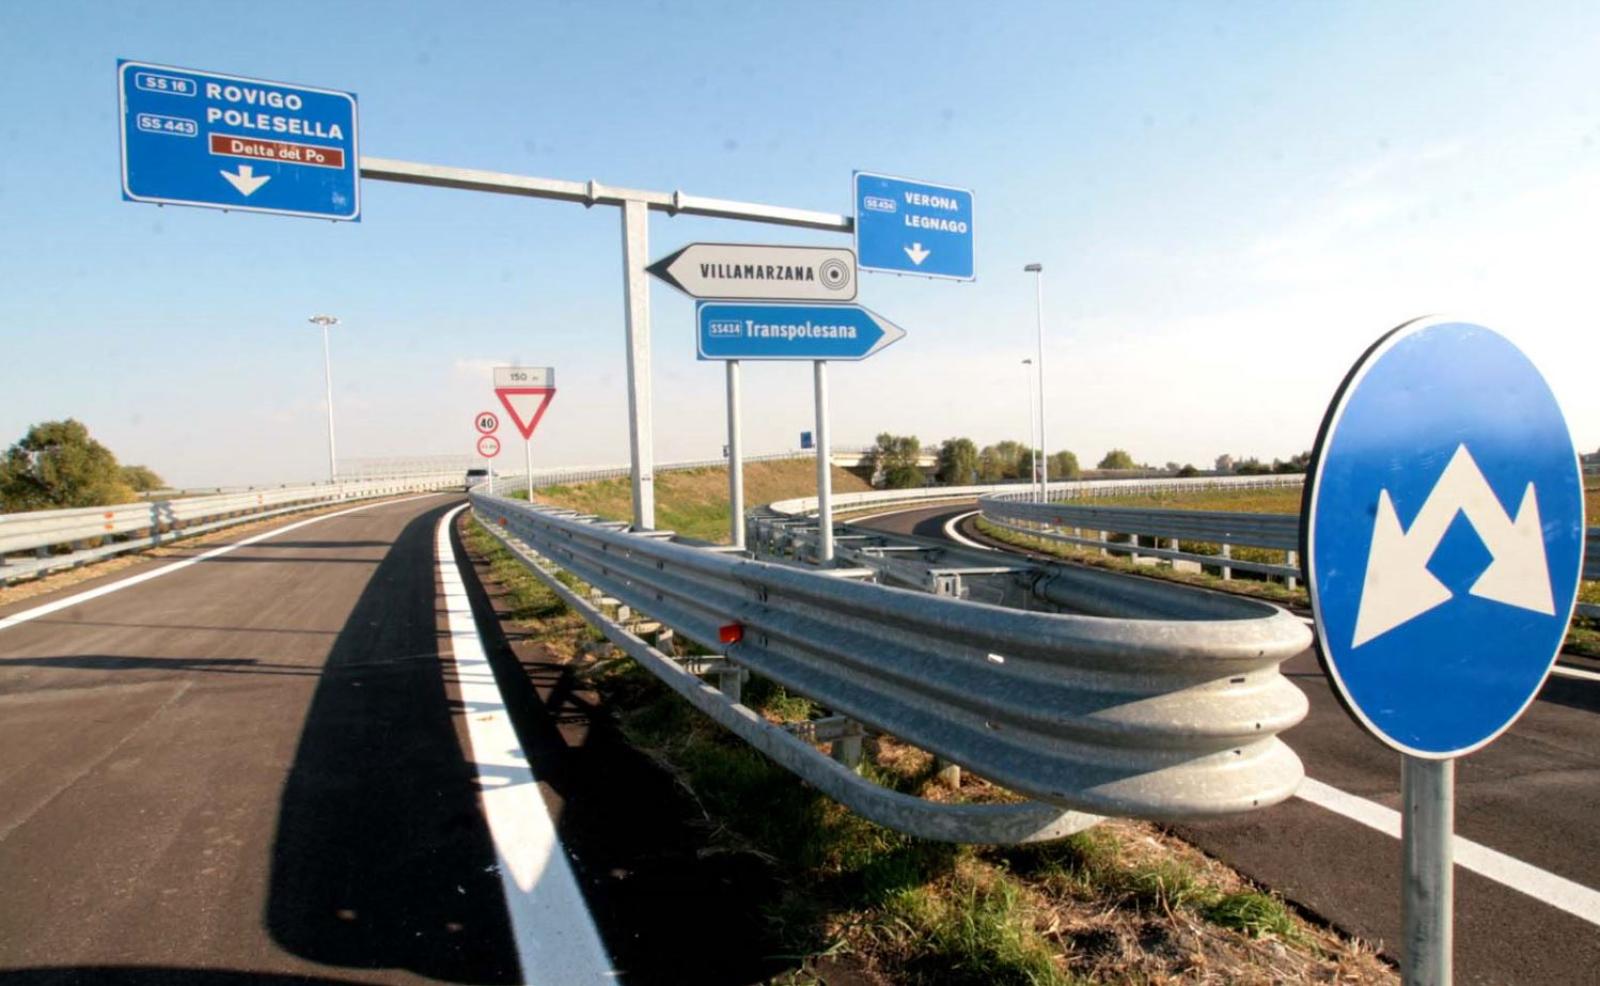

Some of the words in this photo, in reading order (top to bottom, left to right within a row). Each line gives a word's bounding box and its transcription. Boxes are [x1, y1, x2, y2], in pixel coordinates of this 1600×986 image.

[146, 76, 167, 90] SS
[172, 80, 187, 92] 16
[206, 82, 302, 111] ROVIGO
[141, 117, 161, 130] SS
[164, 119, 194, 134] 443
[207, 107, 344, 140] POLESELLA
[231, 140, 274, 158] Delta
[279, 145, 301, 161] del
[305, 147, 325, 163] Po
[904, 191, 958, 211] VERONA
[905, 214, 968, 234] LEGNAGO
[700, 263, 815, 281] VILLAMARZANA
[746, 320, 857, 340] Transpolesana
[510, 372, 527, 381] 150
[480, 418, 494, 428] 40
